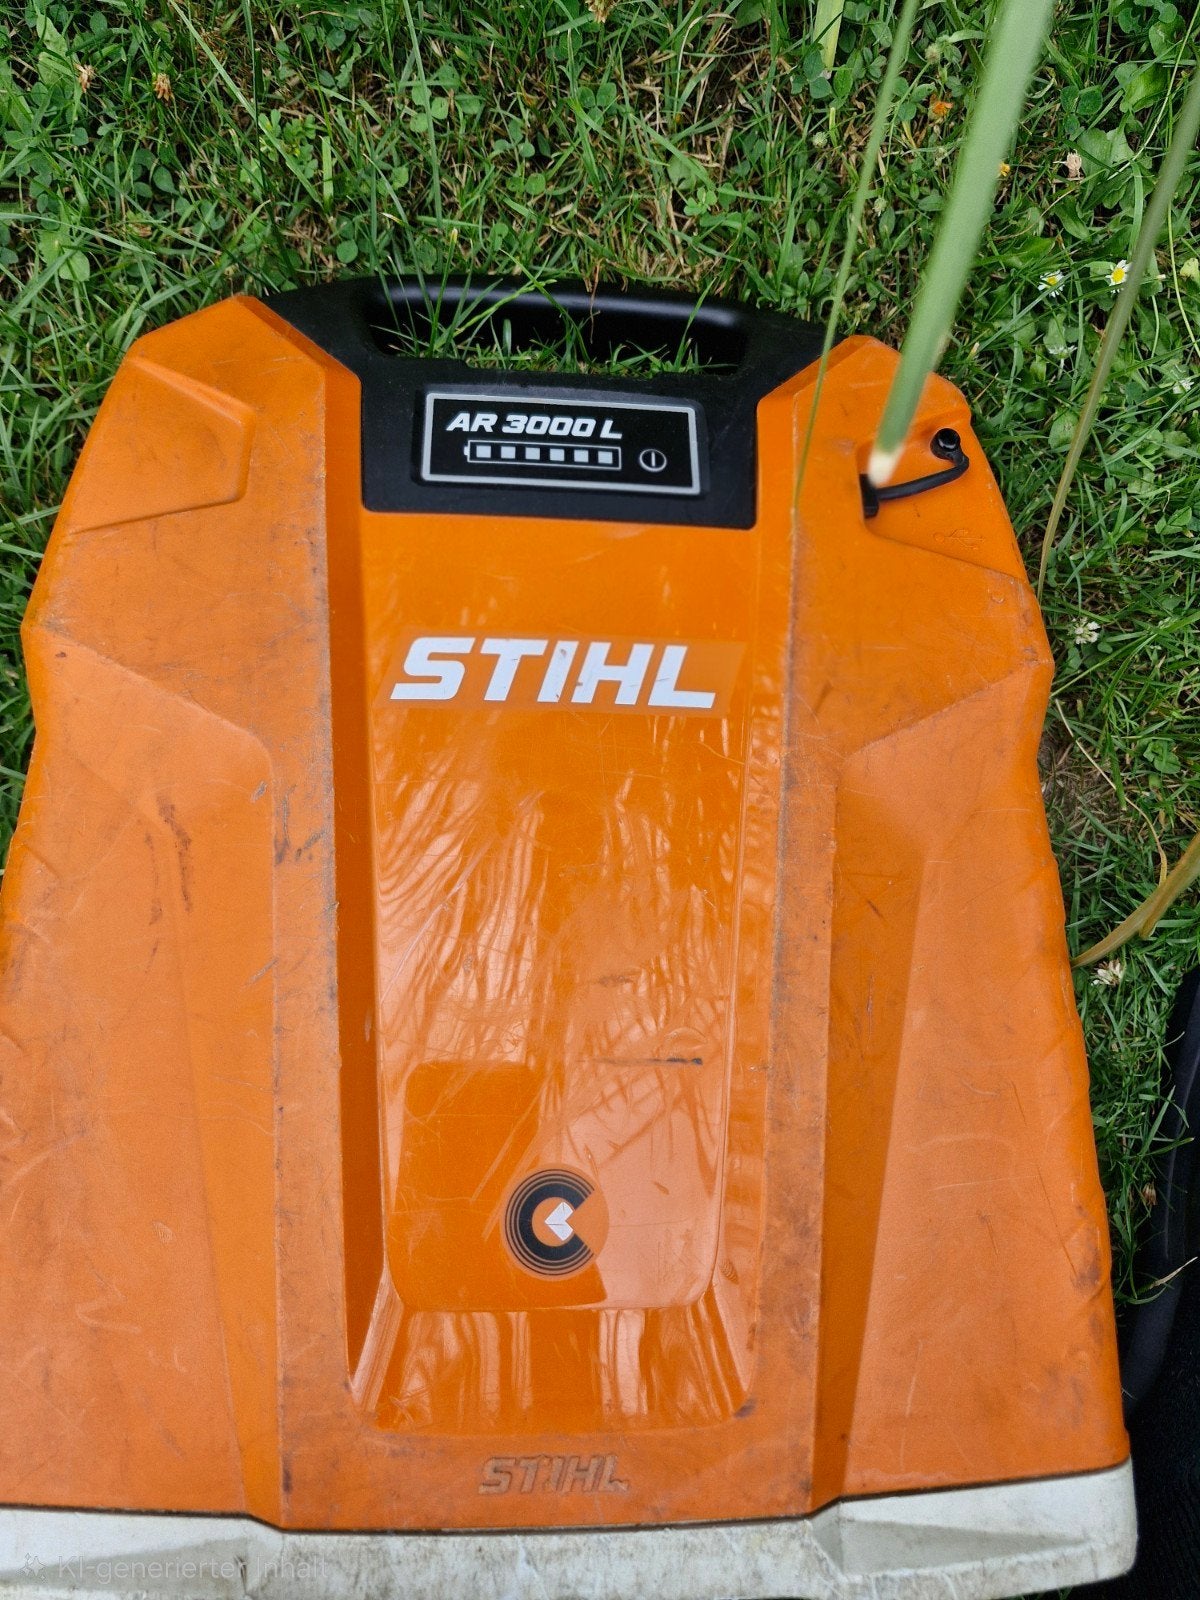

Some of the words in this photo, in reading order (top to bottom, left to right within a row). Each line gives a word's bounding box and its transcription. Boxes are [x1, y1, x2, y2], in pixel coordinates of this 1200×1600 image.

[446, 412, 499, 433] AR
[501, 414, 597, 438] 3000
[600, 419, 623, 439] L
[390, 636, 716, 709] STIHL
[478, 1454, 630, 1496] STIHL
